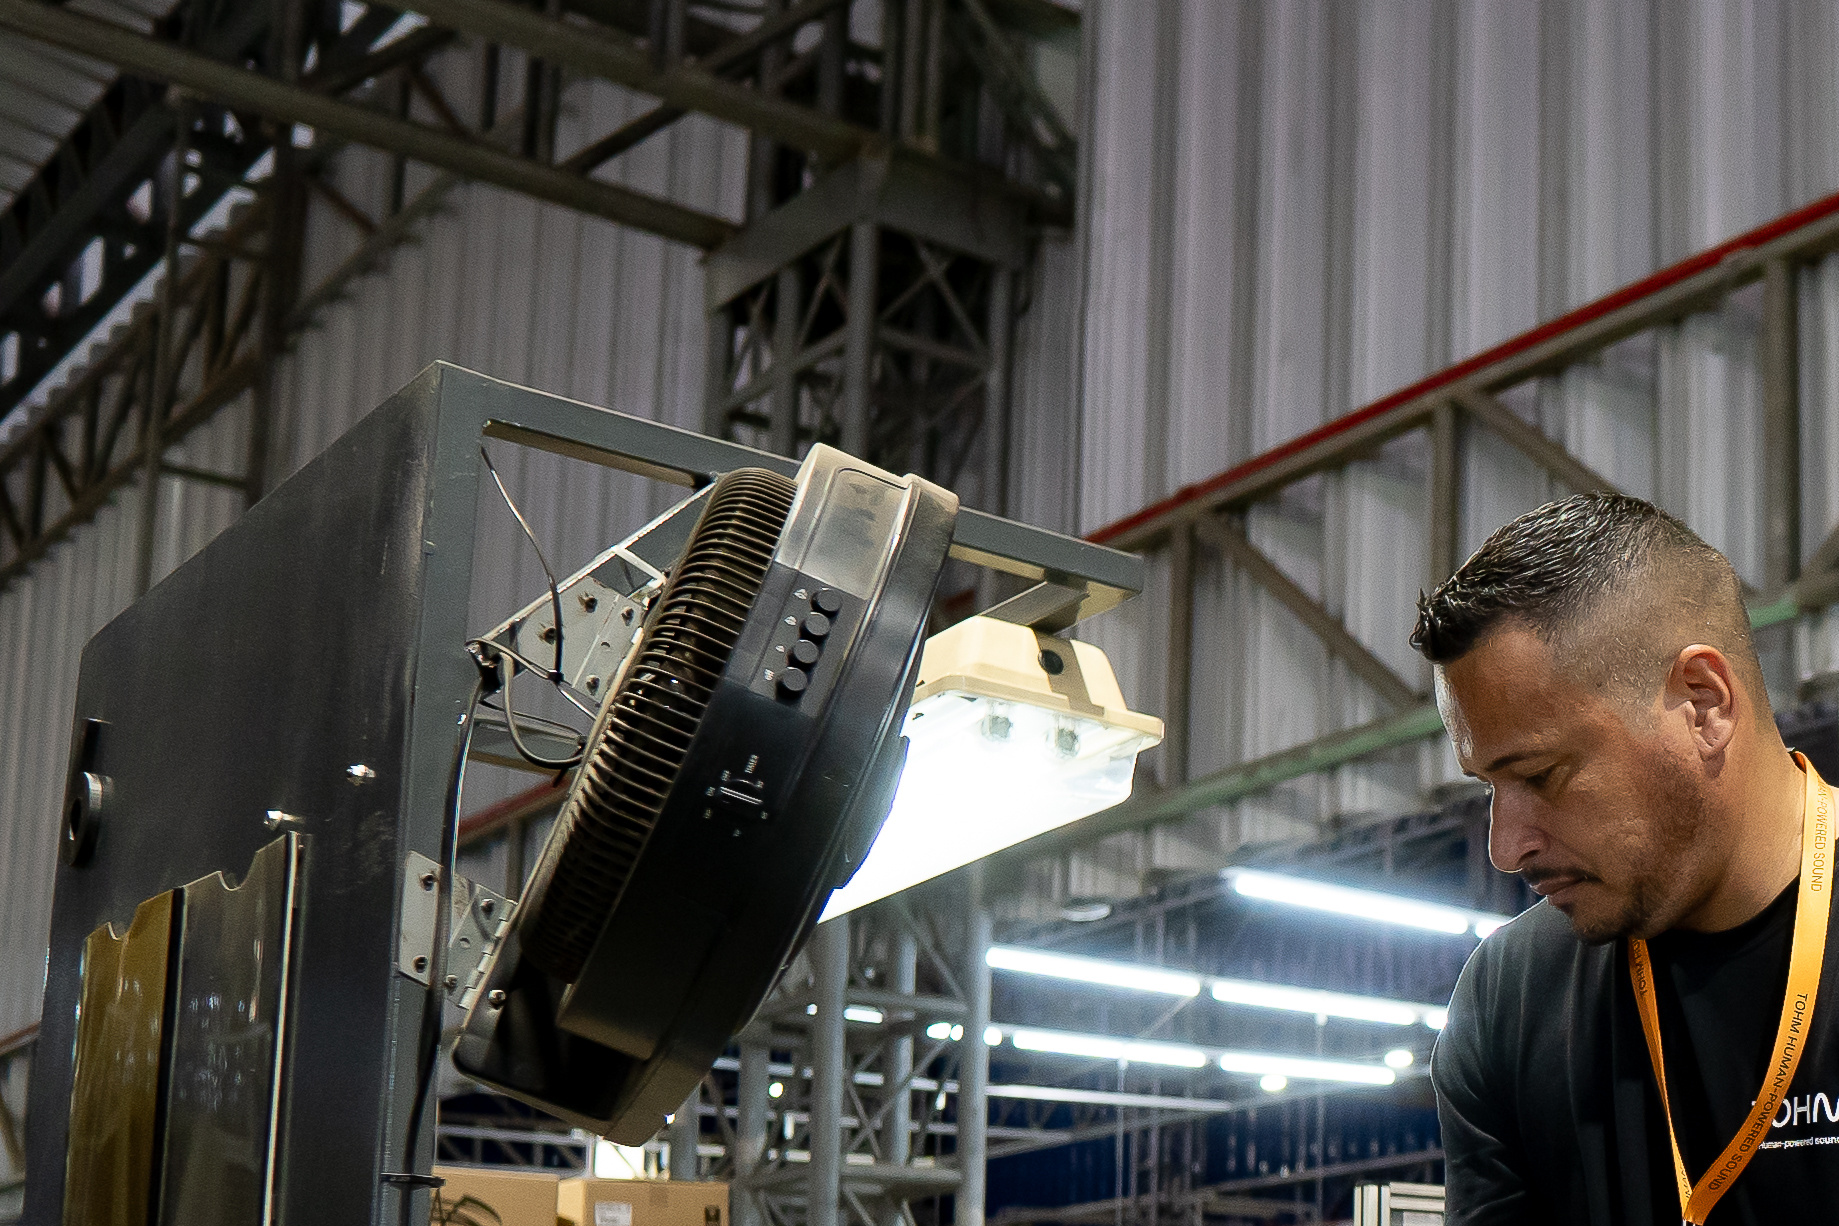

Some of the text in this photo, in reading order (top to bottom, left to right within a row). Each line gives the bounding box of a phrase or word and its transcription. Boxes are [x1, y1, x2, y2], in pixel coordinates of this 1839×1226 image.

[1810, 852, 1826, 893] SOUND
[1708, 993, 1809, 1191] TOHM HUMAN-POWERED SOUND
